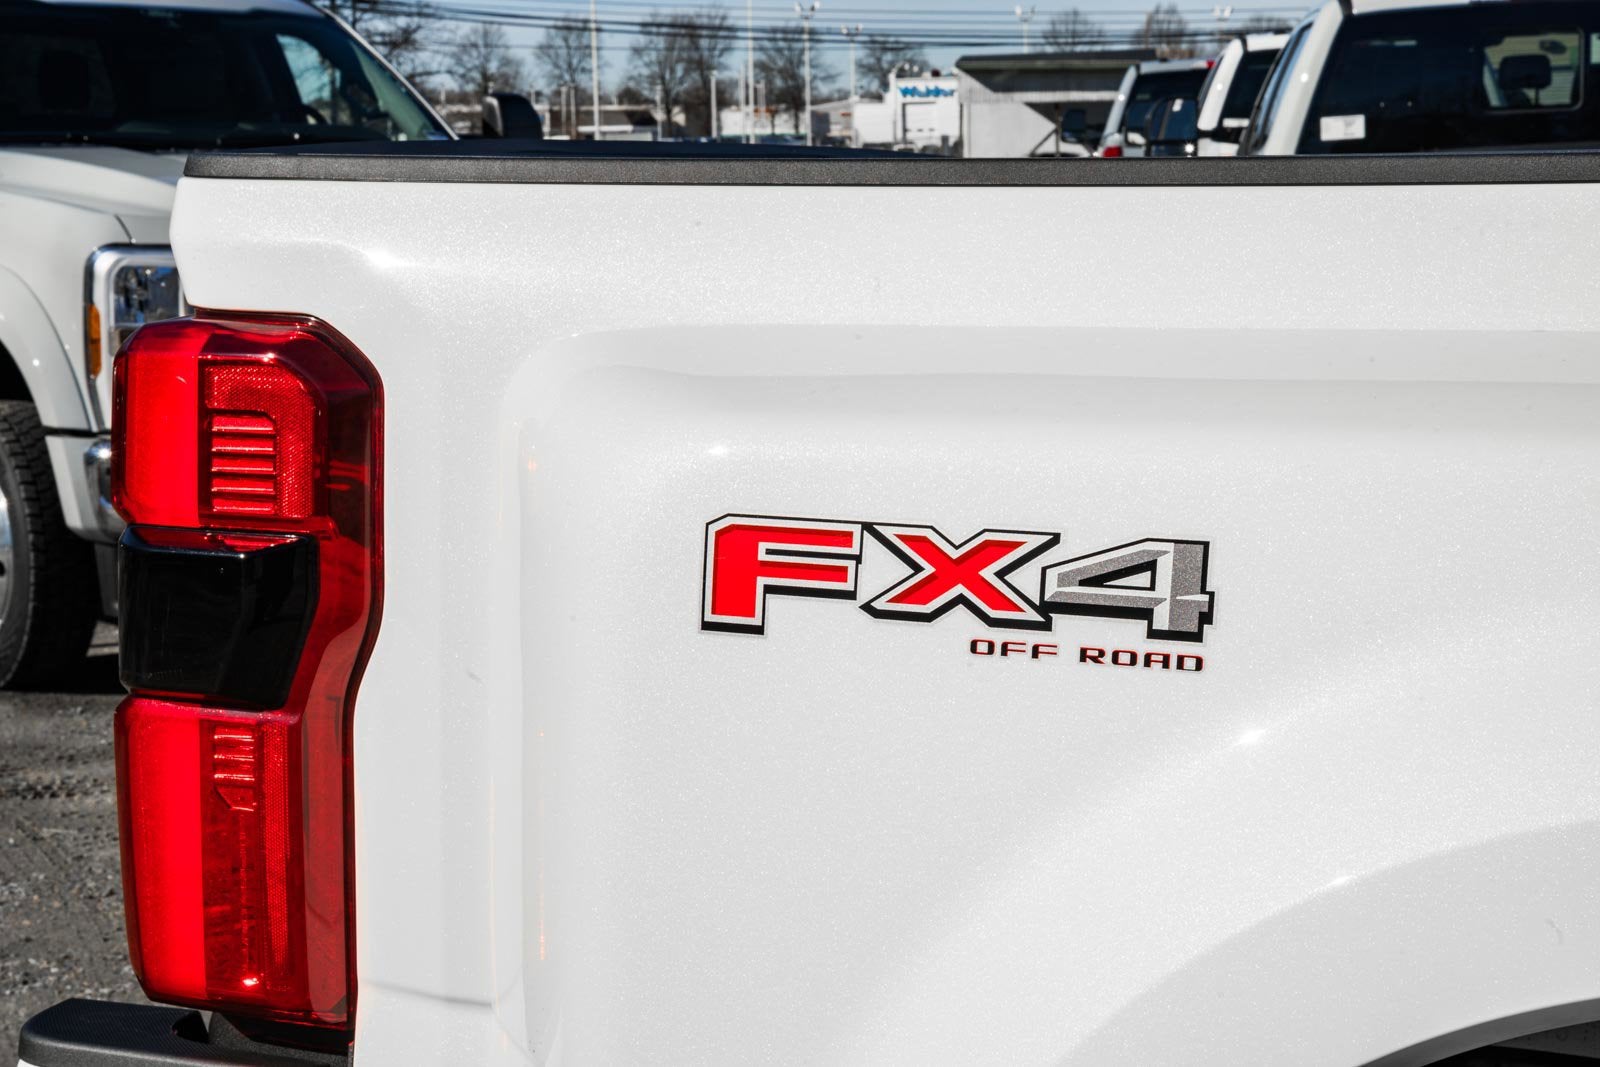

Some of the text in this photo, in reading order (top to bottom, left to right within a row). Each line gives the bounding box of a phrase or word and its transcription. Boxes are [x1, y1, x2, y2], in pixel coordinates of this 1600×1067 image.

[701, 513, 1215, 643] FX4
[970, 639, 1203, 672] OFF ROAD
